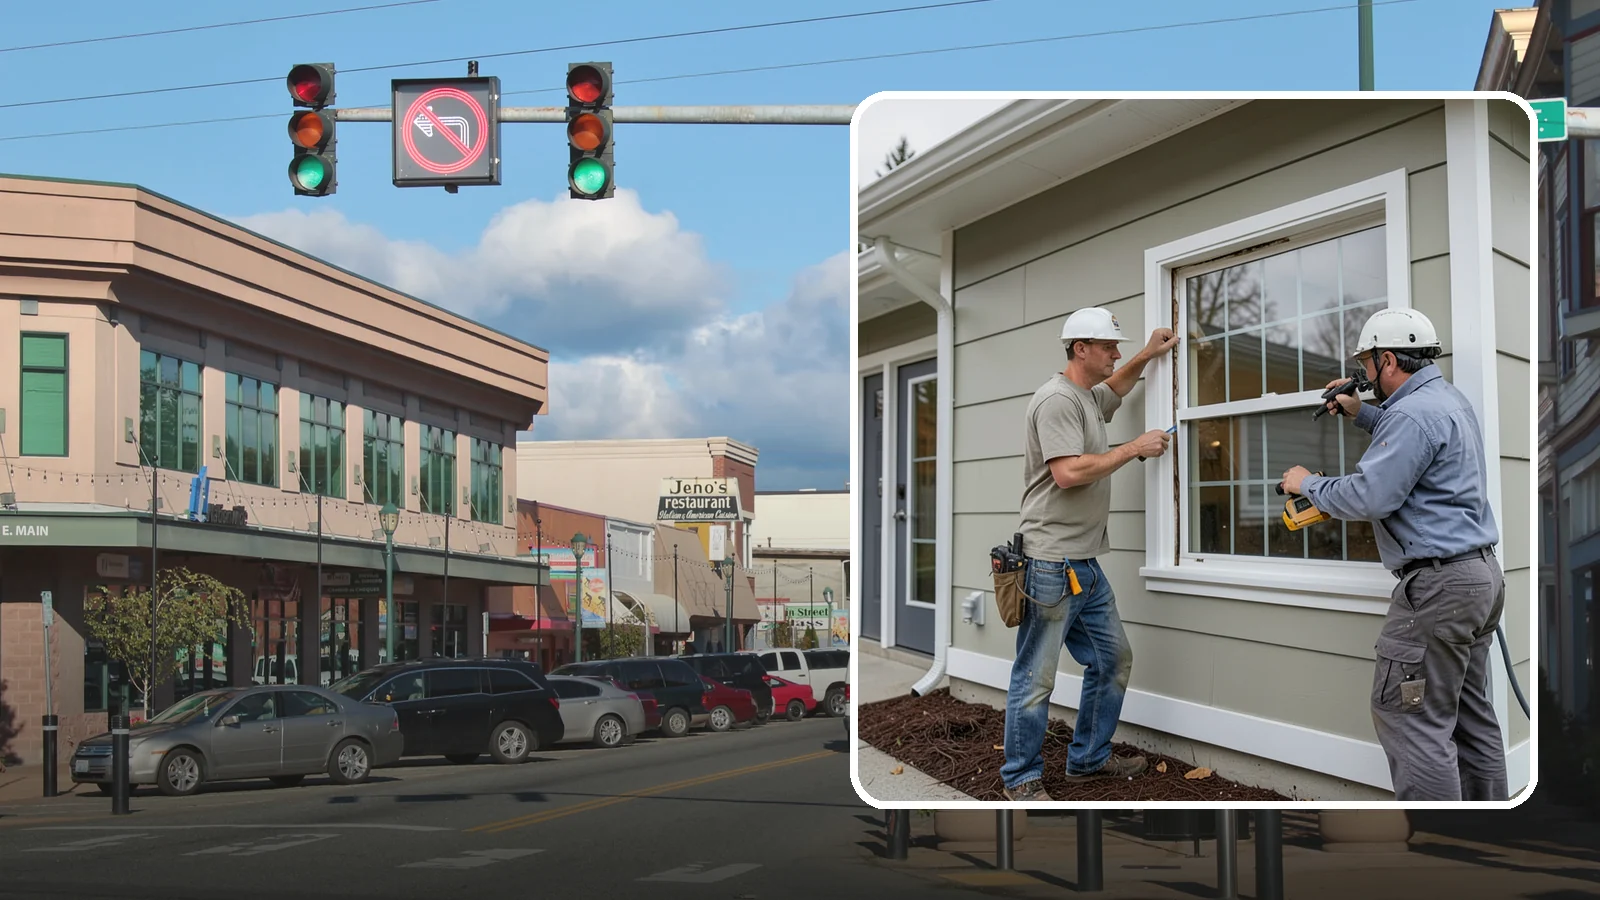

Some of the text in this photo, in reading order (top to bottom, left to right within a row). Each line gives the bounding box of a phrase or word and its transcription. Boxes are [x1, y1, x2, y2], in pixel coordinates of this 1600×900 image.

[670, 480, 727, 494] Jeno's
[665, 496, 731, 509] restaurant
[658, 509, 681, 519] Italian
[686, 509, 714, 519] American
[715, 509, 737, 519] Cuisine
[2, 525, 49, 536] E. MAIN
[786, 607, 795, 617] in
[797, 607, 829, 617] Street
[791, 619, 824, 627] lass
